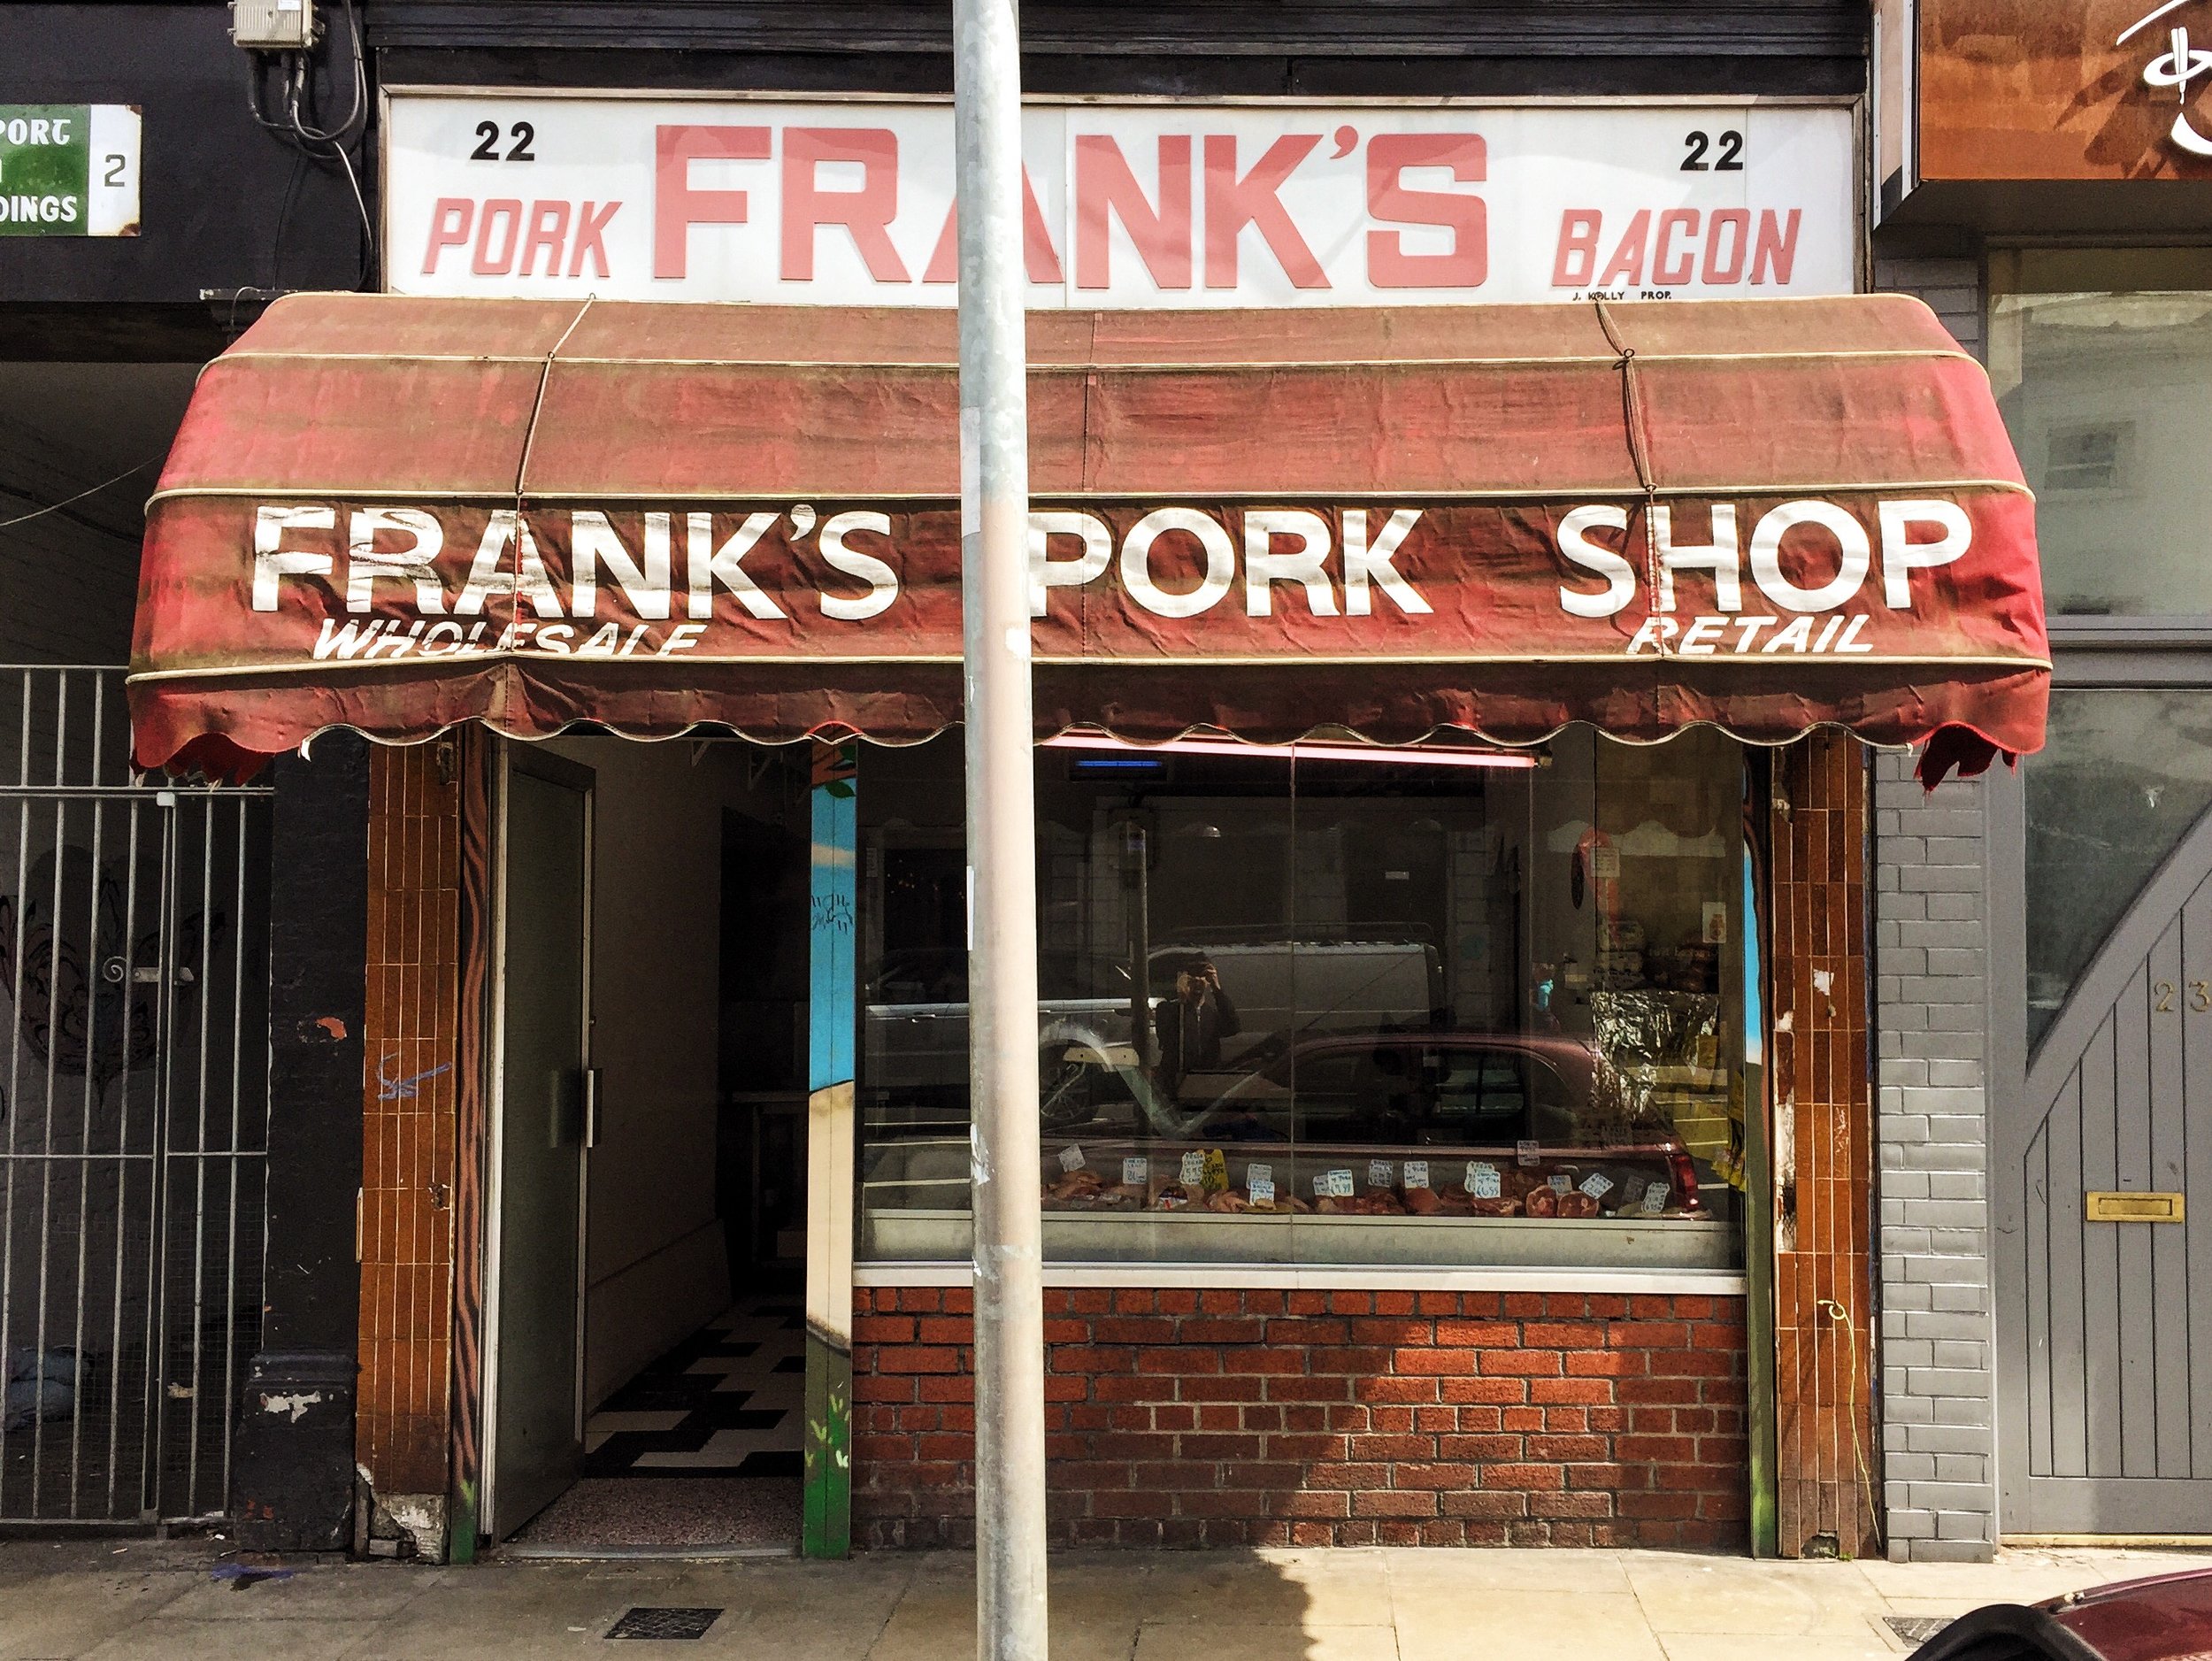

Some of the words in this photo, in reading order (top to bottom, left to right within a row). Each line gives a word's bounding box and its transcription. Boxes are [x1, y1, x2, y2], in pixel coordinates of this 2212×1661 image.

[472, 121, 535, 161] 22
[1679, 131, 1743, 172] 22
[104, 154, 126, 187] 2
[421, 198, 622, 278] PORK
[1552, 209, 1802, 286] BACON
[1640, 291, 1671, 300] PROP.
[252, 504, 899, 620] FRANK'S
[1028, 507, 1434, 619] PORK
[1556, 499, 1973, 619] SHOP
[1626, 614, 1874, 655] RETAIL
[2154, 981, 2210, 1011] 23
